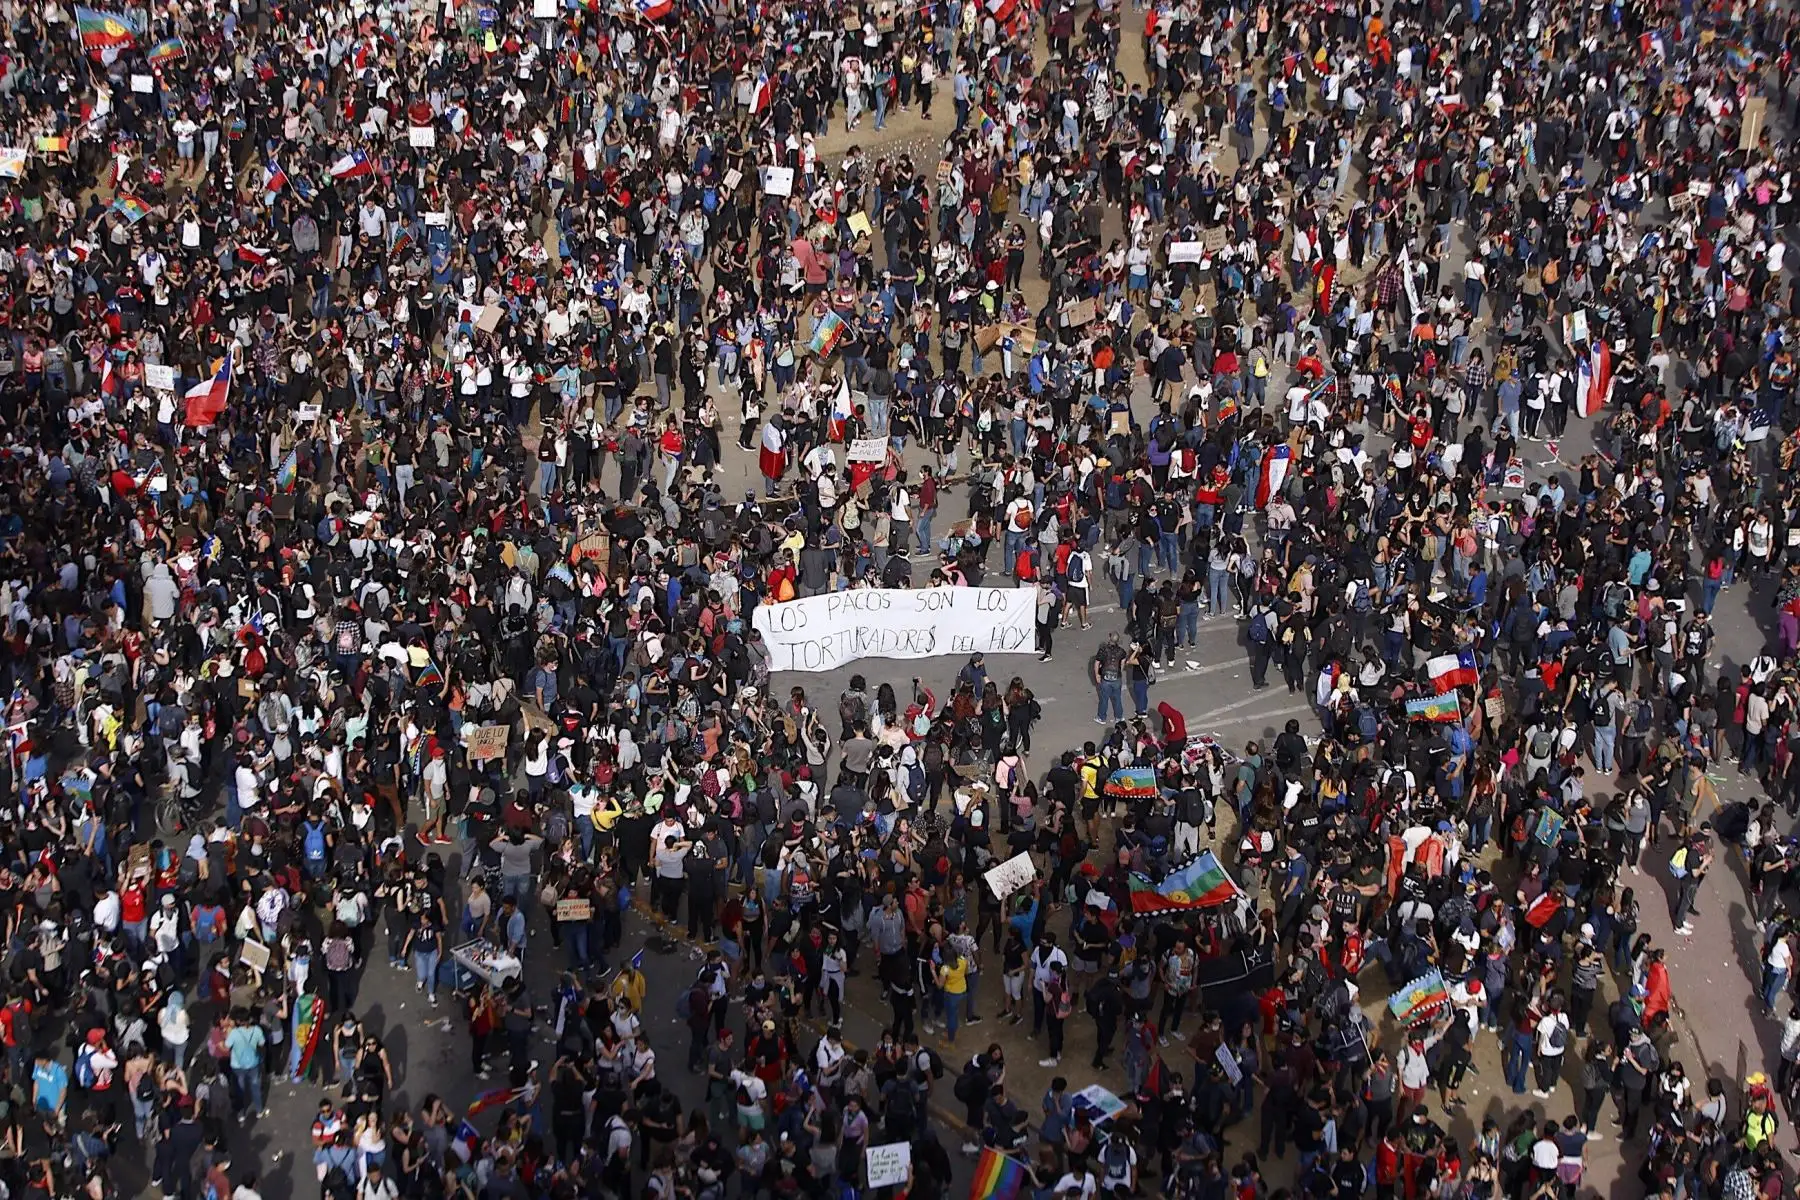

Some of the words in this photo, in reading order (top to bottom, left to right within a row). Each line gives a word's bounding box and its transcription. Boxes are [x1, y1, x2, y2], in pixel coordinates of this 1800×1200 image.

[768, 604, 807, 633] LOS
[828, 591, 891, 620] PACOS
[915, 591, 954, 612] SON
[977, 590, 1010, 612] LOS
[952, 635, 976, 651] DEL
[475, 728, 492, 739] QUE
[493, 727, 504, 738] LO
